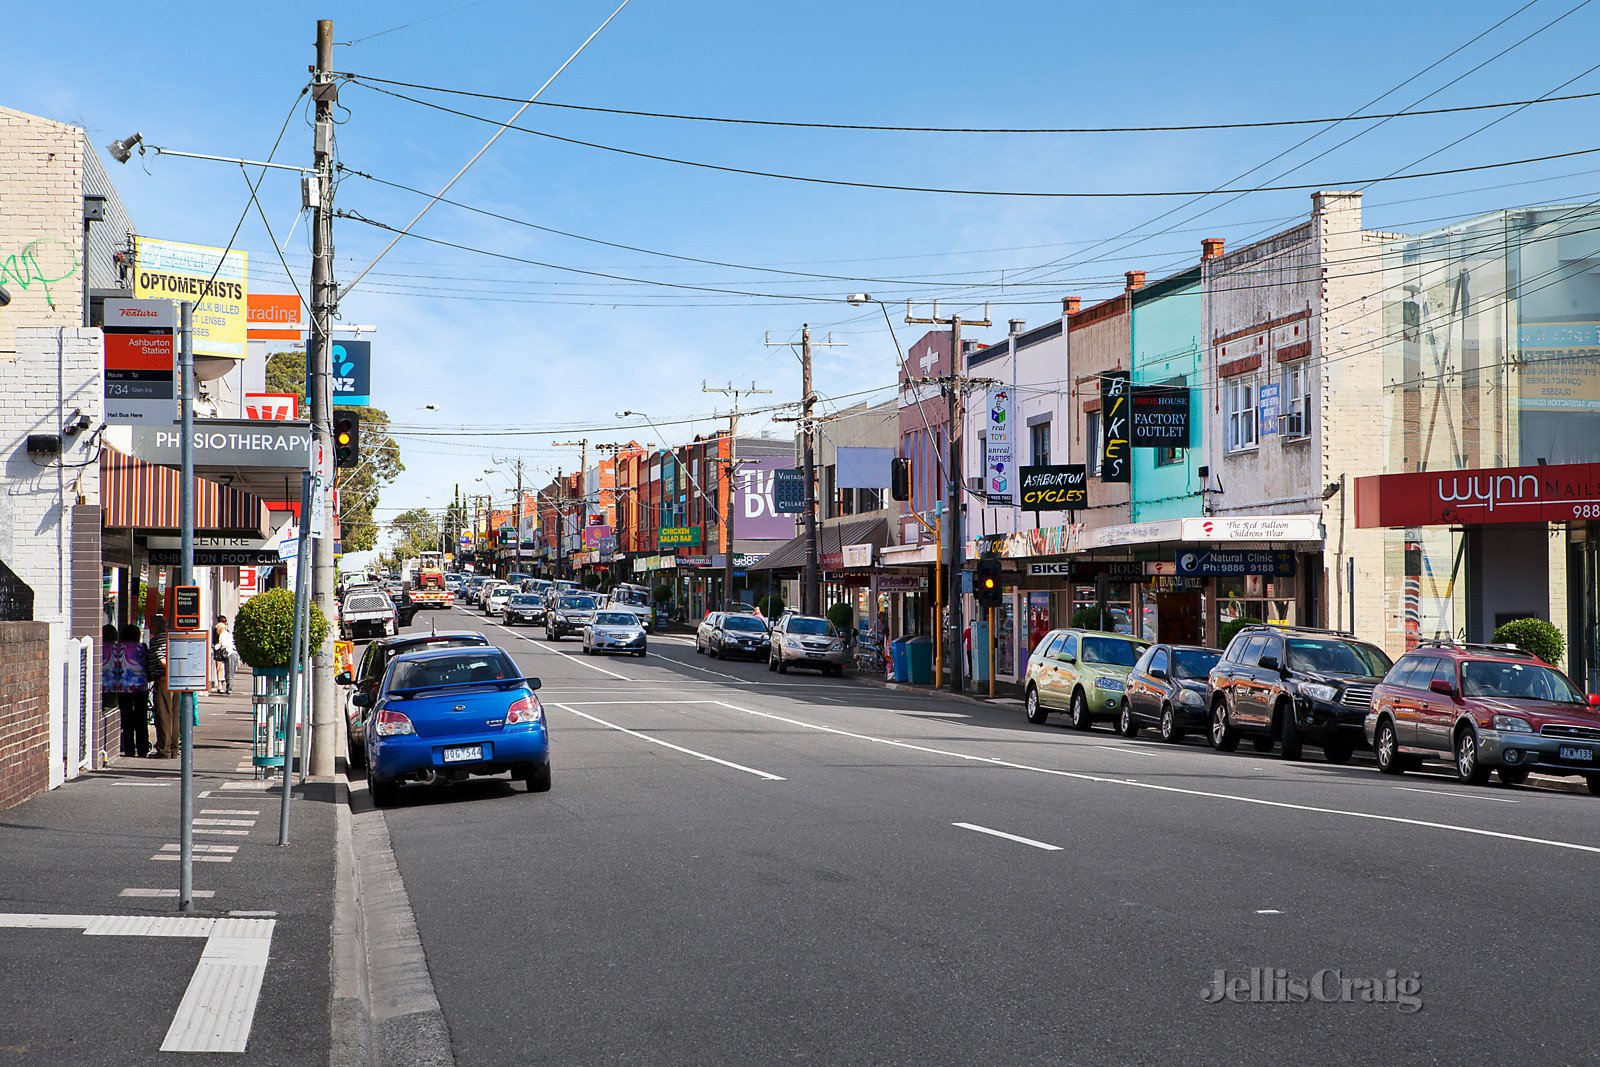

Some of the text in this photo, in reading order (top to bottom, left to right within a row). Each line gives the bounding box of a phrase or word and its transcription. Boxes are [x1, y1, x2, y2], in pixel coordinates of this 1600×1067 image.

[140, 272, 242, 300] OPTOMETRISTS
[119, 308, 158, 318] Ventura
[214, 302, 240, 315] BILLED
[201, 316, 226, 326] LENSES
[128, 339, 170, 348] Ashburton
[142, 346, 170, 355] Station
[108, 384, 129, 395] 734
[332, 378, 354, 392] NZ
[1134, 414, 1186, 424] FACTORY
[1106, 378, 1128, 477] BIKES
[1136, 426, 1184, 437] OUTLET
[156, 432, 310, 451] PHSIOTHERAPY
[1024, 472, 1084, 488] ASHBURTON
[1024, 489, 1085, 504] CYCLES
[1438, 474, 1538, 512] wynn
[1227, 520, 1288, 530] The Red Balloon
[1230, 529, 1284, 538] Childrens Wear
[150, 554, 288, 564] ASHBTON FOOT CLIN
[1210, 553, 1273, 562] Natural Clinic
[1250, 564, 1274, 572] 9188
